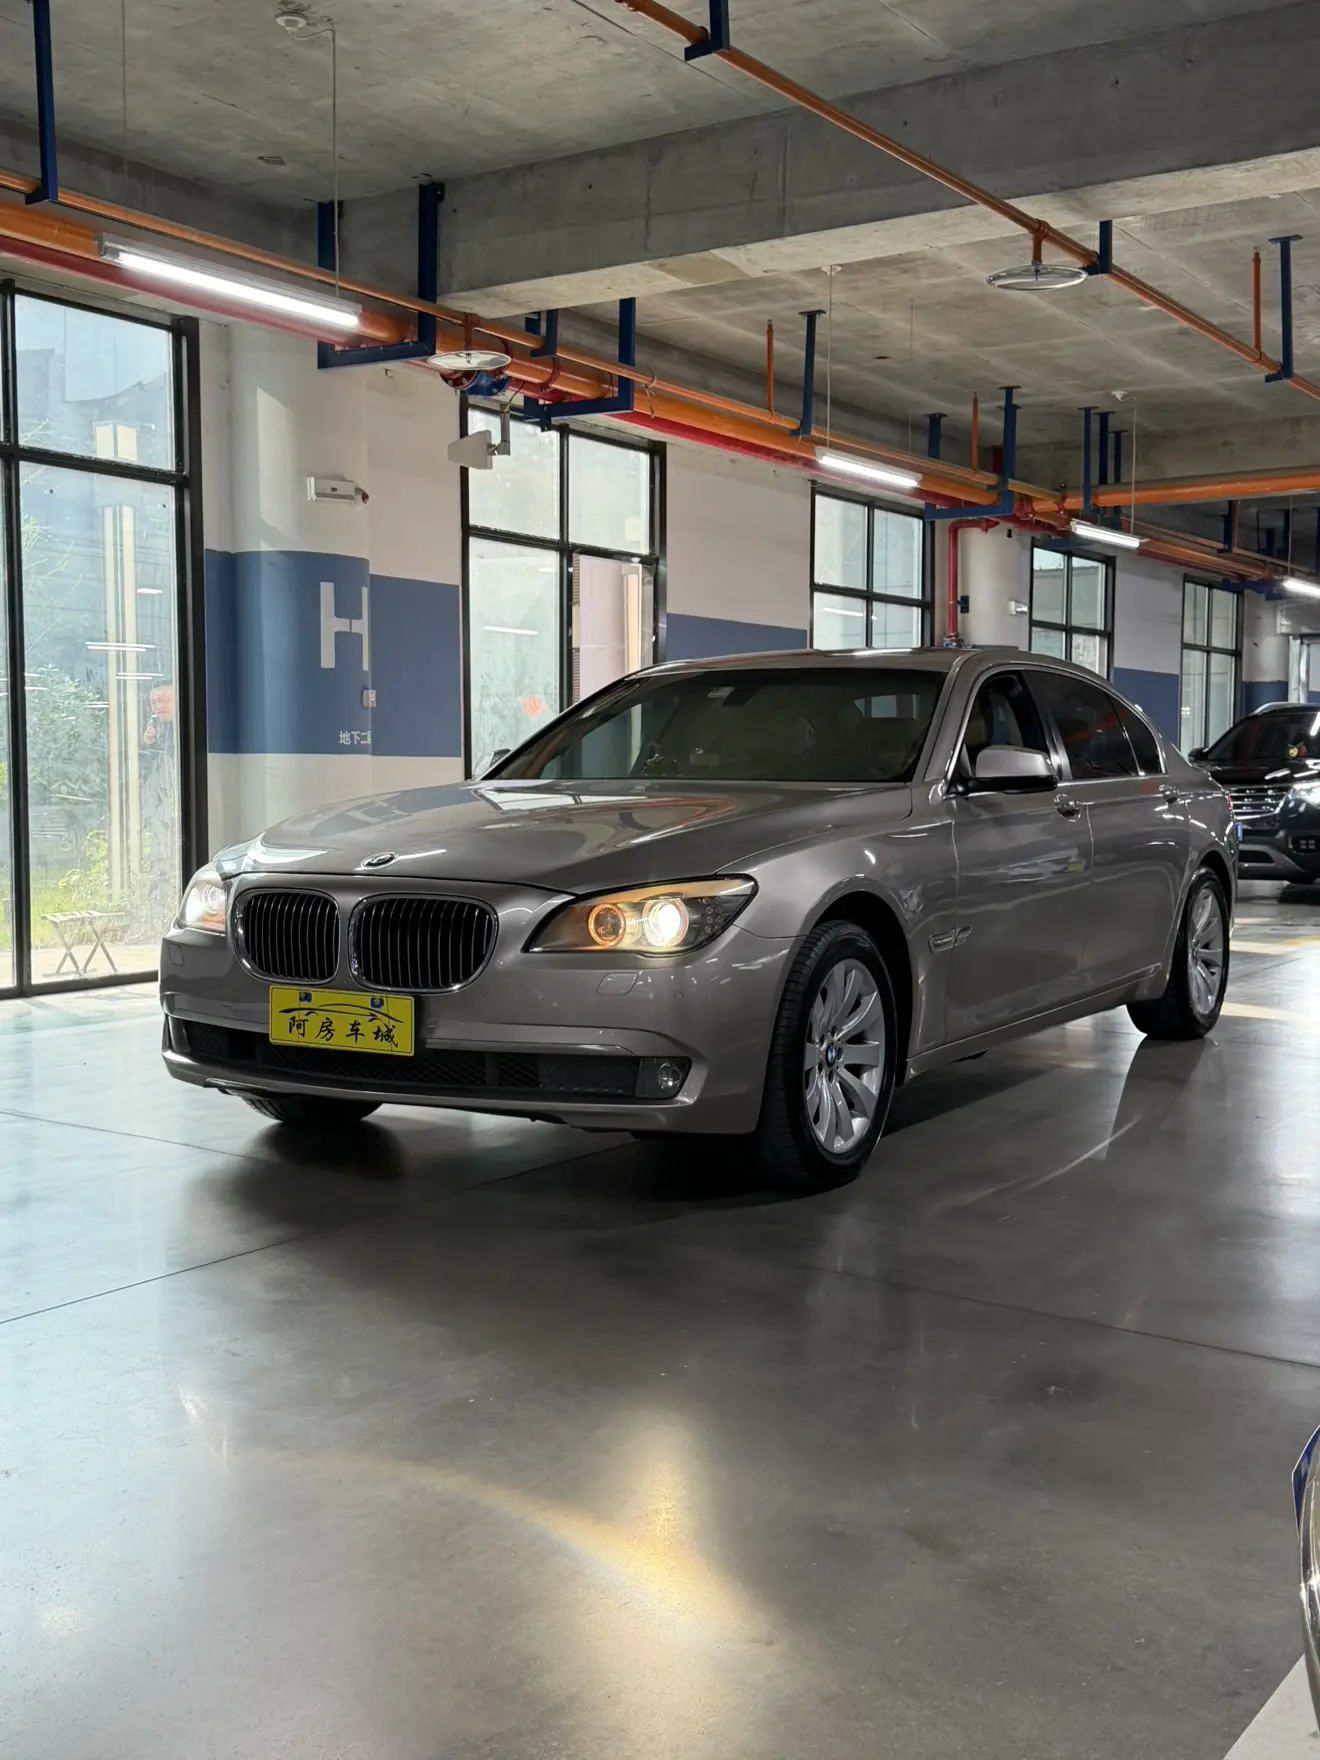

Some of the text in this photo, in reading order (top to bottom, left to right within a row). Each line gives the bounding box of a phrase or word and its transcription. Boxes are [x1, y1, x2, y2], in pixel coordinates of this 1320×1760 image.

[320, 581, 369, 671] H
[288, 1016, 399, 1048] 阿房车城
